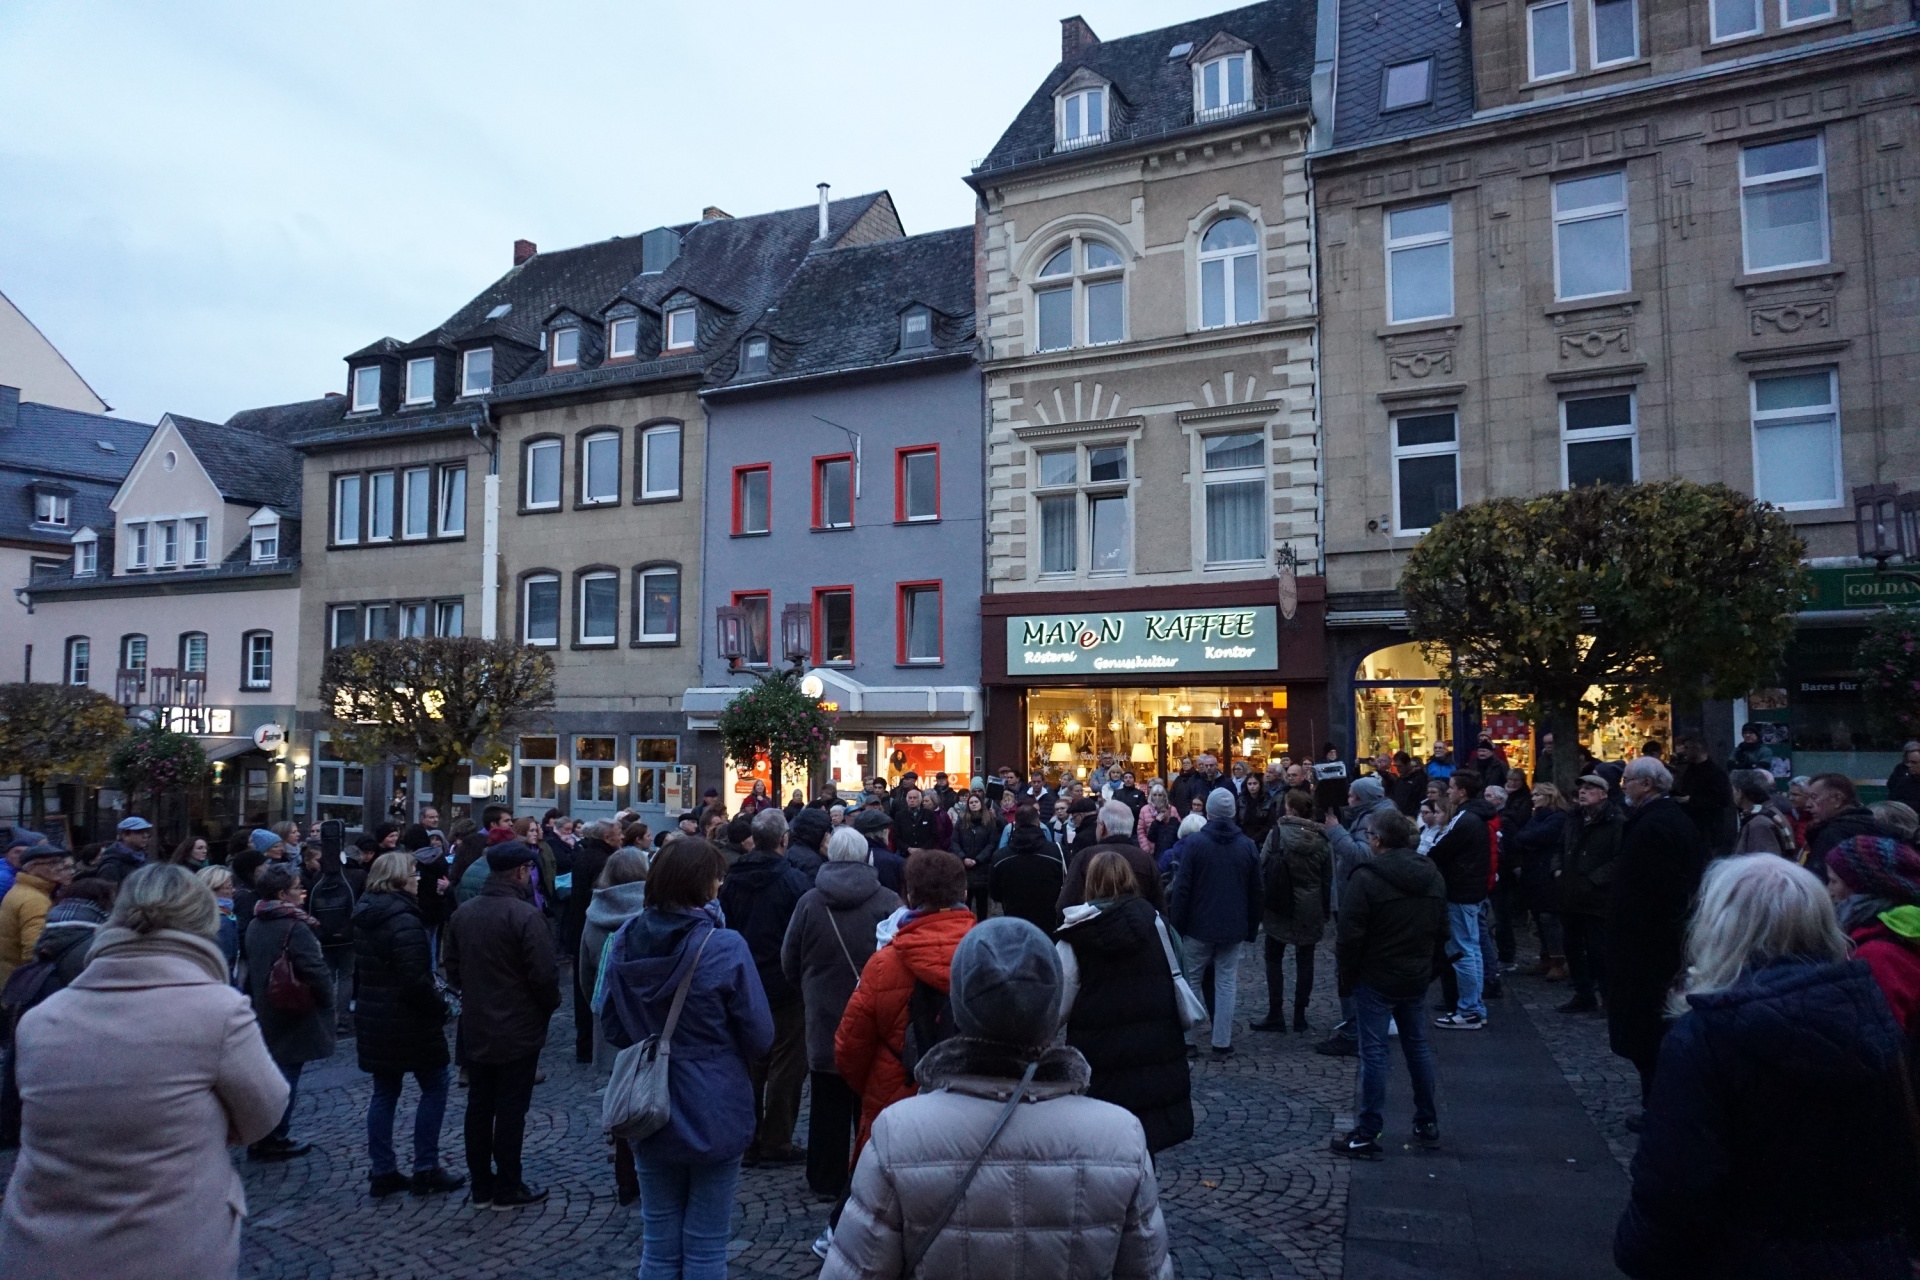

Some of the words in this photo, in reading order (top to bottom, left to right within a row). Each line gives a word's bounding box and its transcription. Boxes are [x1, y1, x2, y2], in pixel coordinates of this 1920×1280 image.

[1023, 617, 1123, 649] MAYeN
[1145, 612, 1255, 641] KAFFEE
[1024, 651, 1077, 663] Rösterei
[1205, 646, 1255, 659] Kontor
[1801, 683, 1835, 691] Bares
[1839, 681, 1857, 691] für
